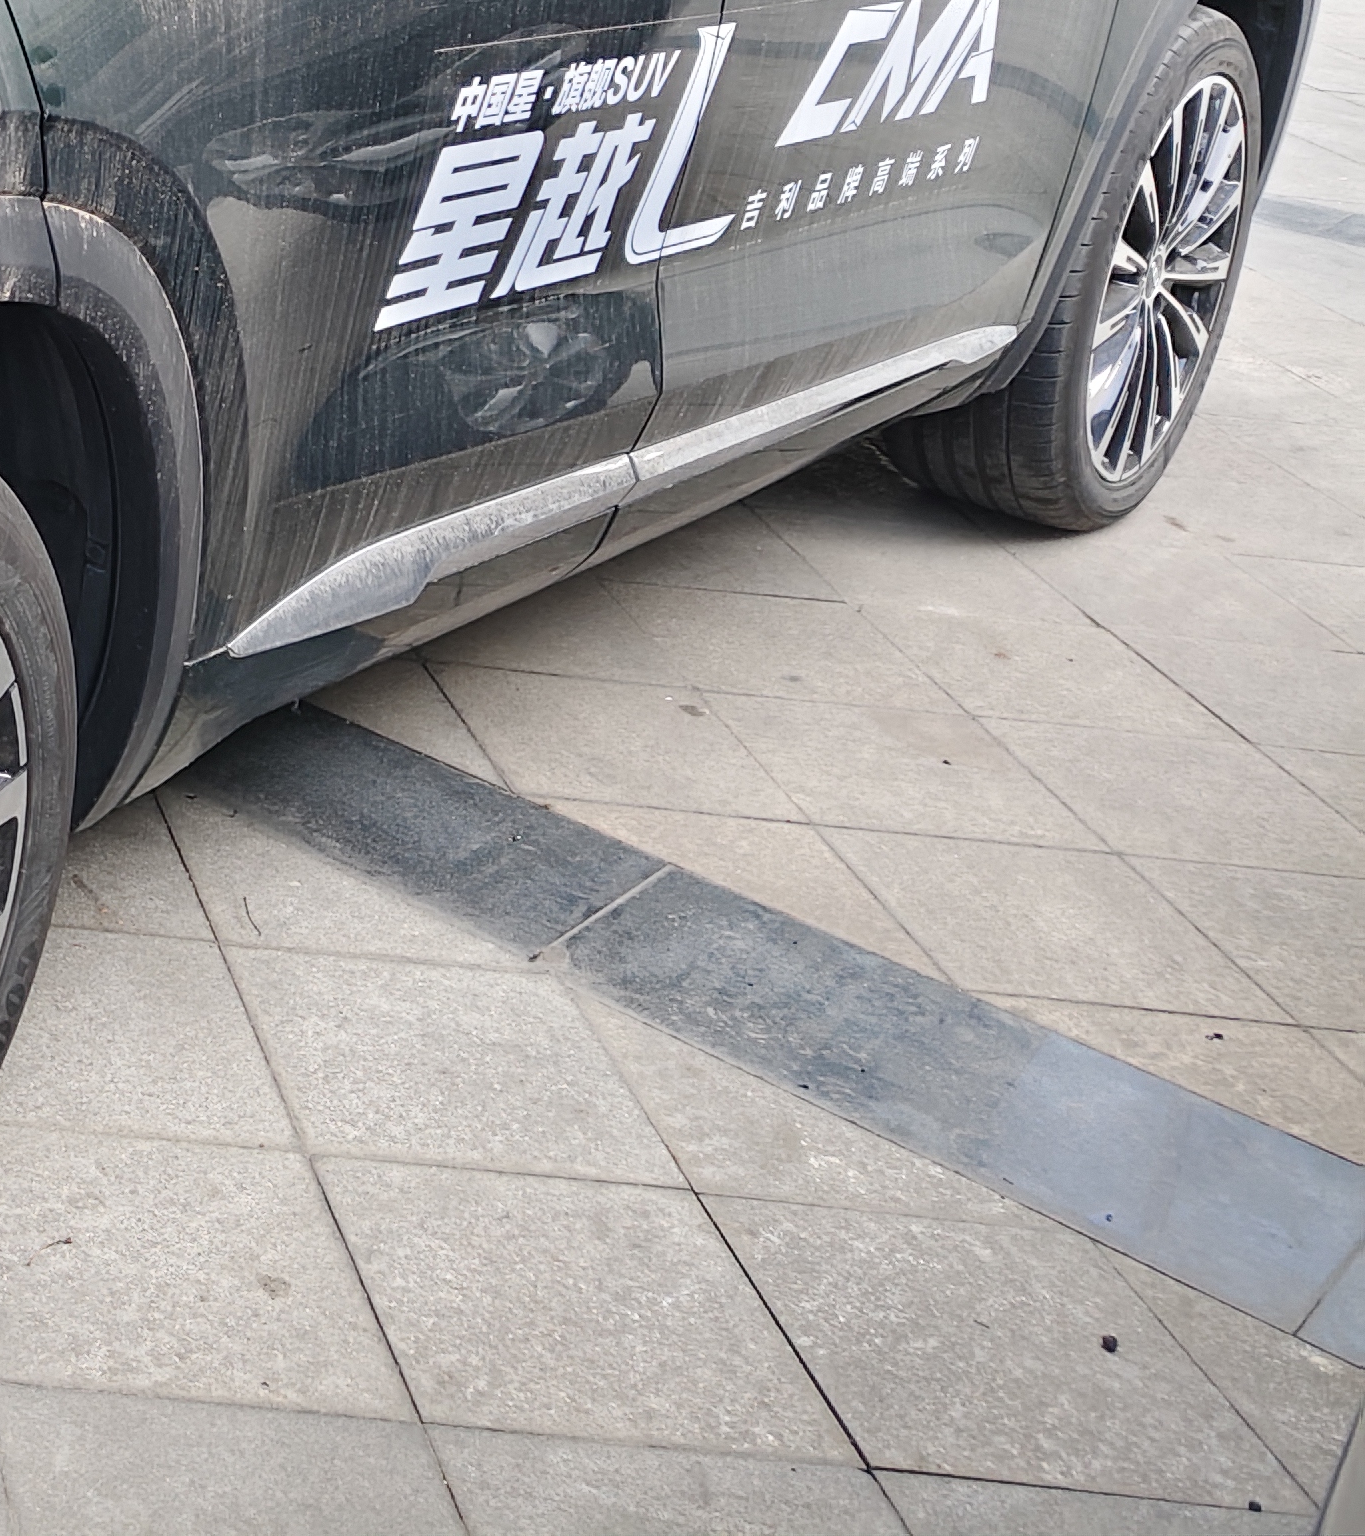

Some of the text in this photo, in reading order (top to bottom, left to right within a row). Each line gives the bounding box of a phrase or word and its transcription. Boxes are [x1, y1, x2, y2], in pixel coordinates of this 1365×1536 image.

[740, 135, 980, 230] 吉利品牌高端系列
